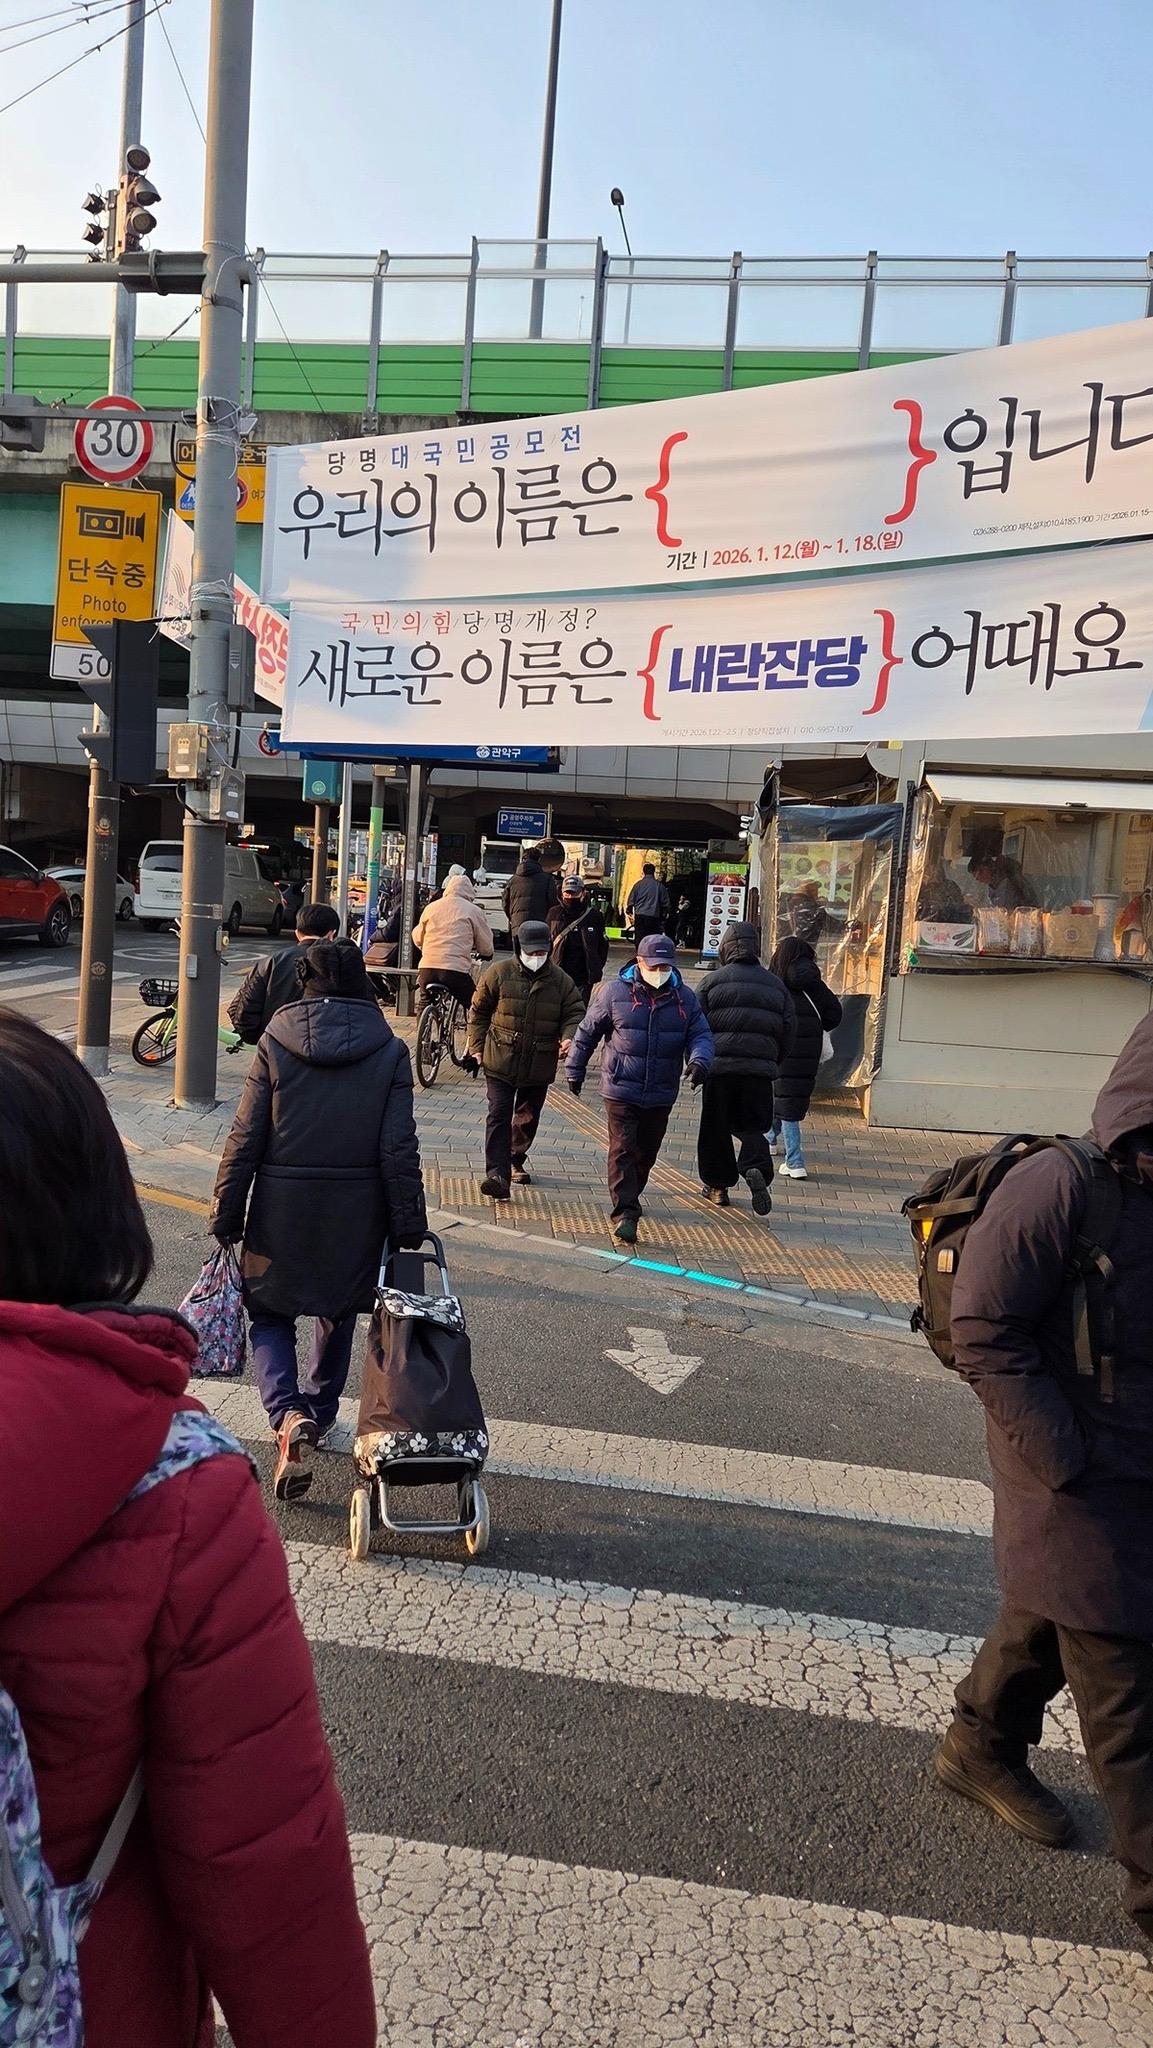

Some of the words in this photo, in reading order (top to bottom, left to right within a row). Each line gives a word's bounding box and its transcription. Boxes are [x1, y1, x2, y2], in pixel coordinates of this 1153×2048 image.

[90, 420, 138, 458] 30
[278, 472, 438, 561] 우리의
[453, 456, 634, 549] 이름은
[68, 557, 147, 588] 단속중
[666, 551, 698, 571] 기간
[82, 594, 127, 614] Photo
[298, 639, 454, 709] 새로운
[460, 637, 628, 710] 이름은
[910, 601, 1144, 696] 어때요
[491, 747, 521, 758] 관악구
[500, 813, 509, 825] P
